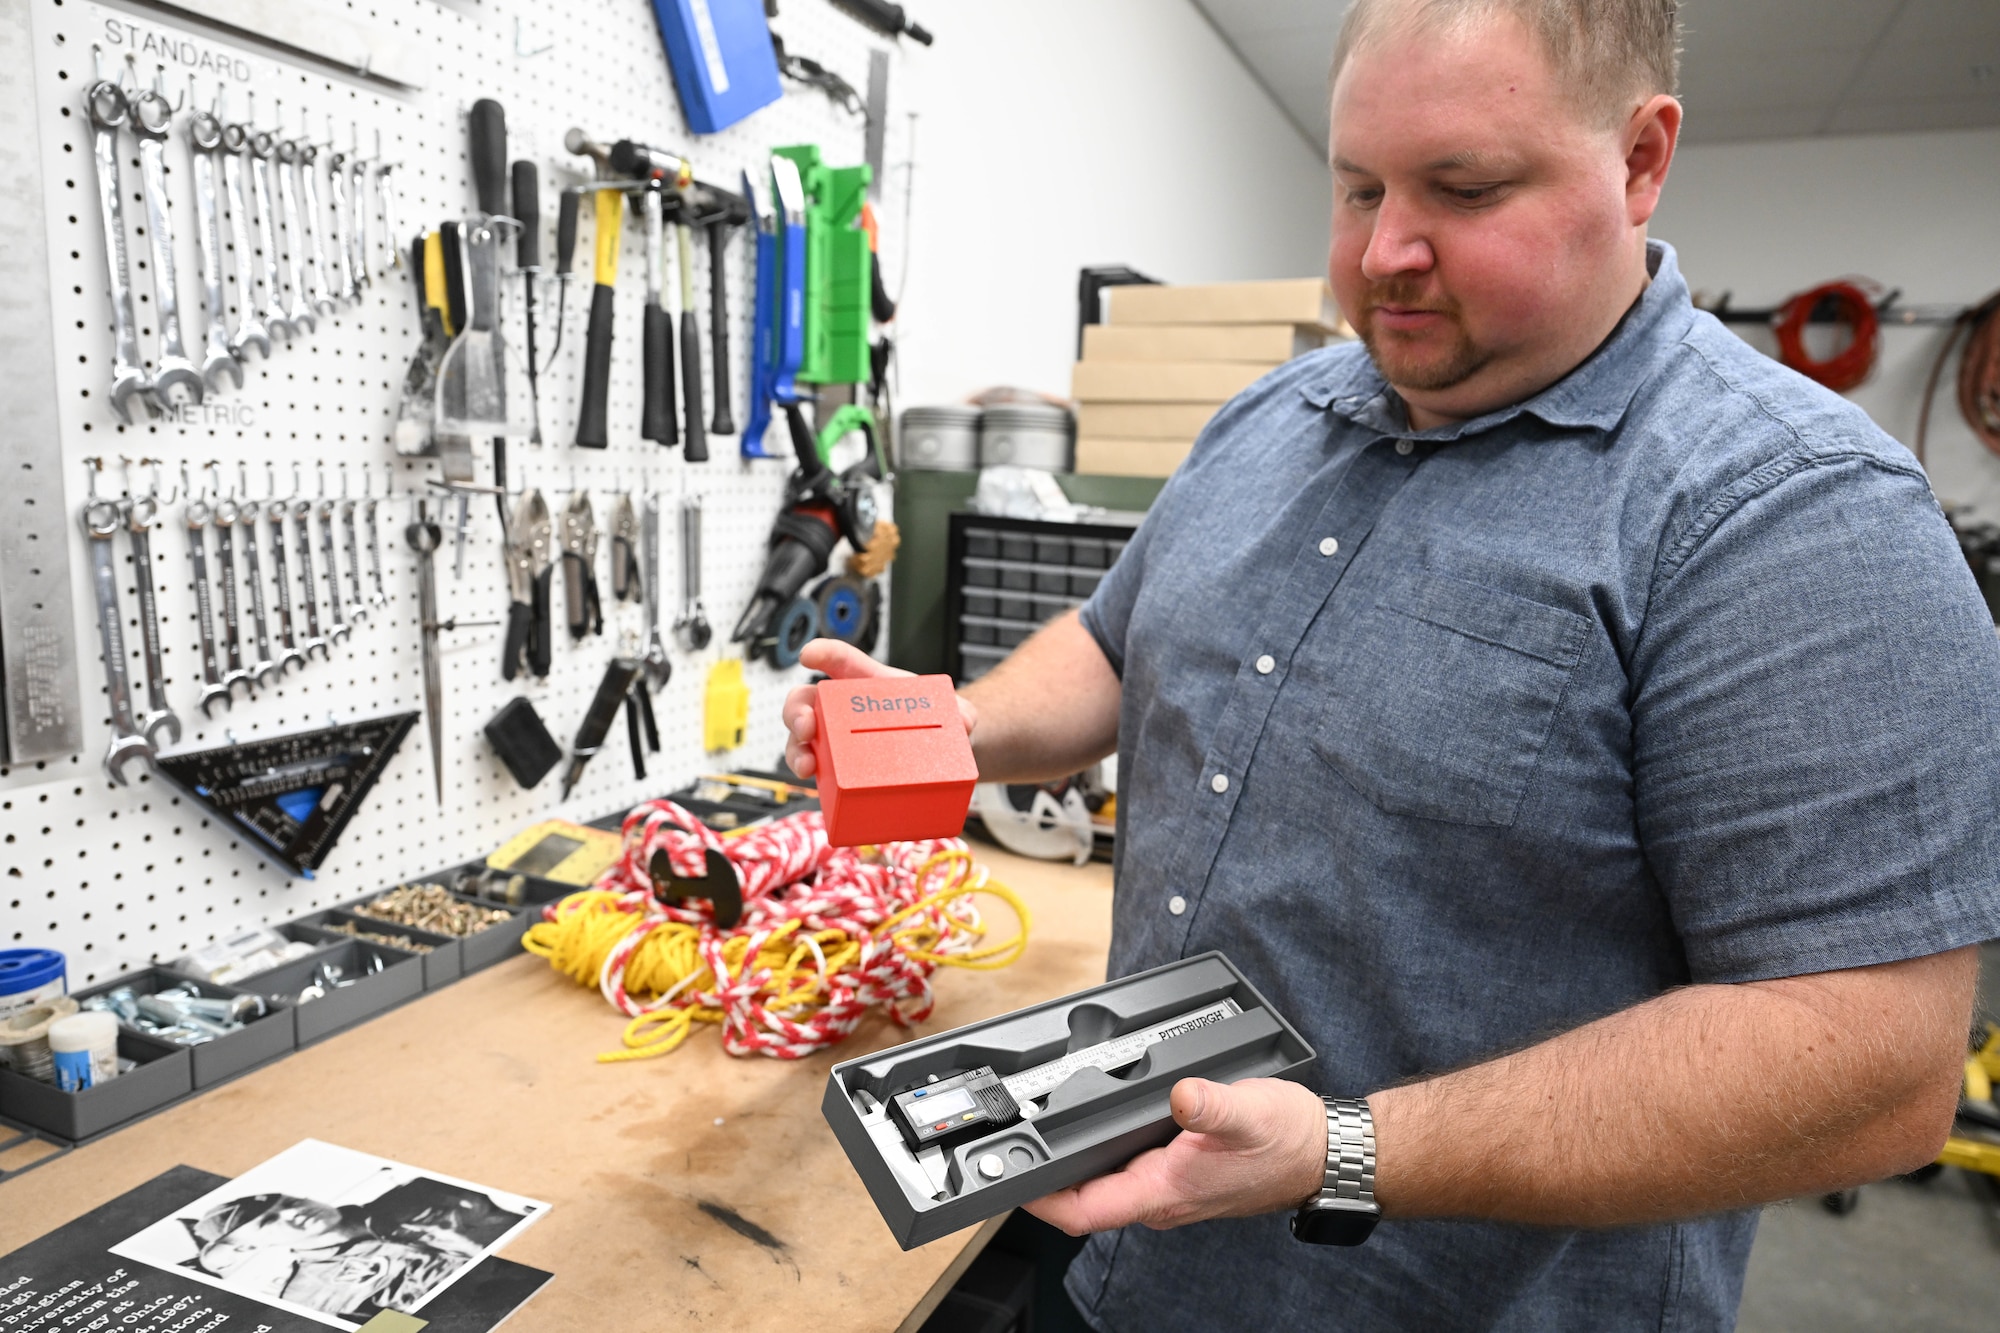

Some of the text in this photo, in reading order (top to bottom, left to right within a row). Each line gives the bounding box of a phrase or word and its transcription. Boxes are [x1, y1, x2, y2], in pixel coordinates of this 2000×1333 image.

[105, 19, 250, 82] STANDARD
[850, 696, 931, 713] Sharps
[923, 1127, 933, 1135] OFF
[107, 1268, 128, 1283] of
[2, 1280, 84, 1325] Brigham
[62, 1280, 140, 1326] from the
[112, 1301, 135, 1314] at
[122, 1295, 174, 1324] Ohio.
[152, 1295, 202, 1324] 1967.
